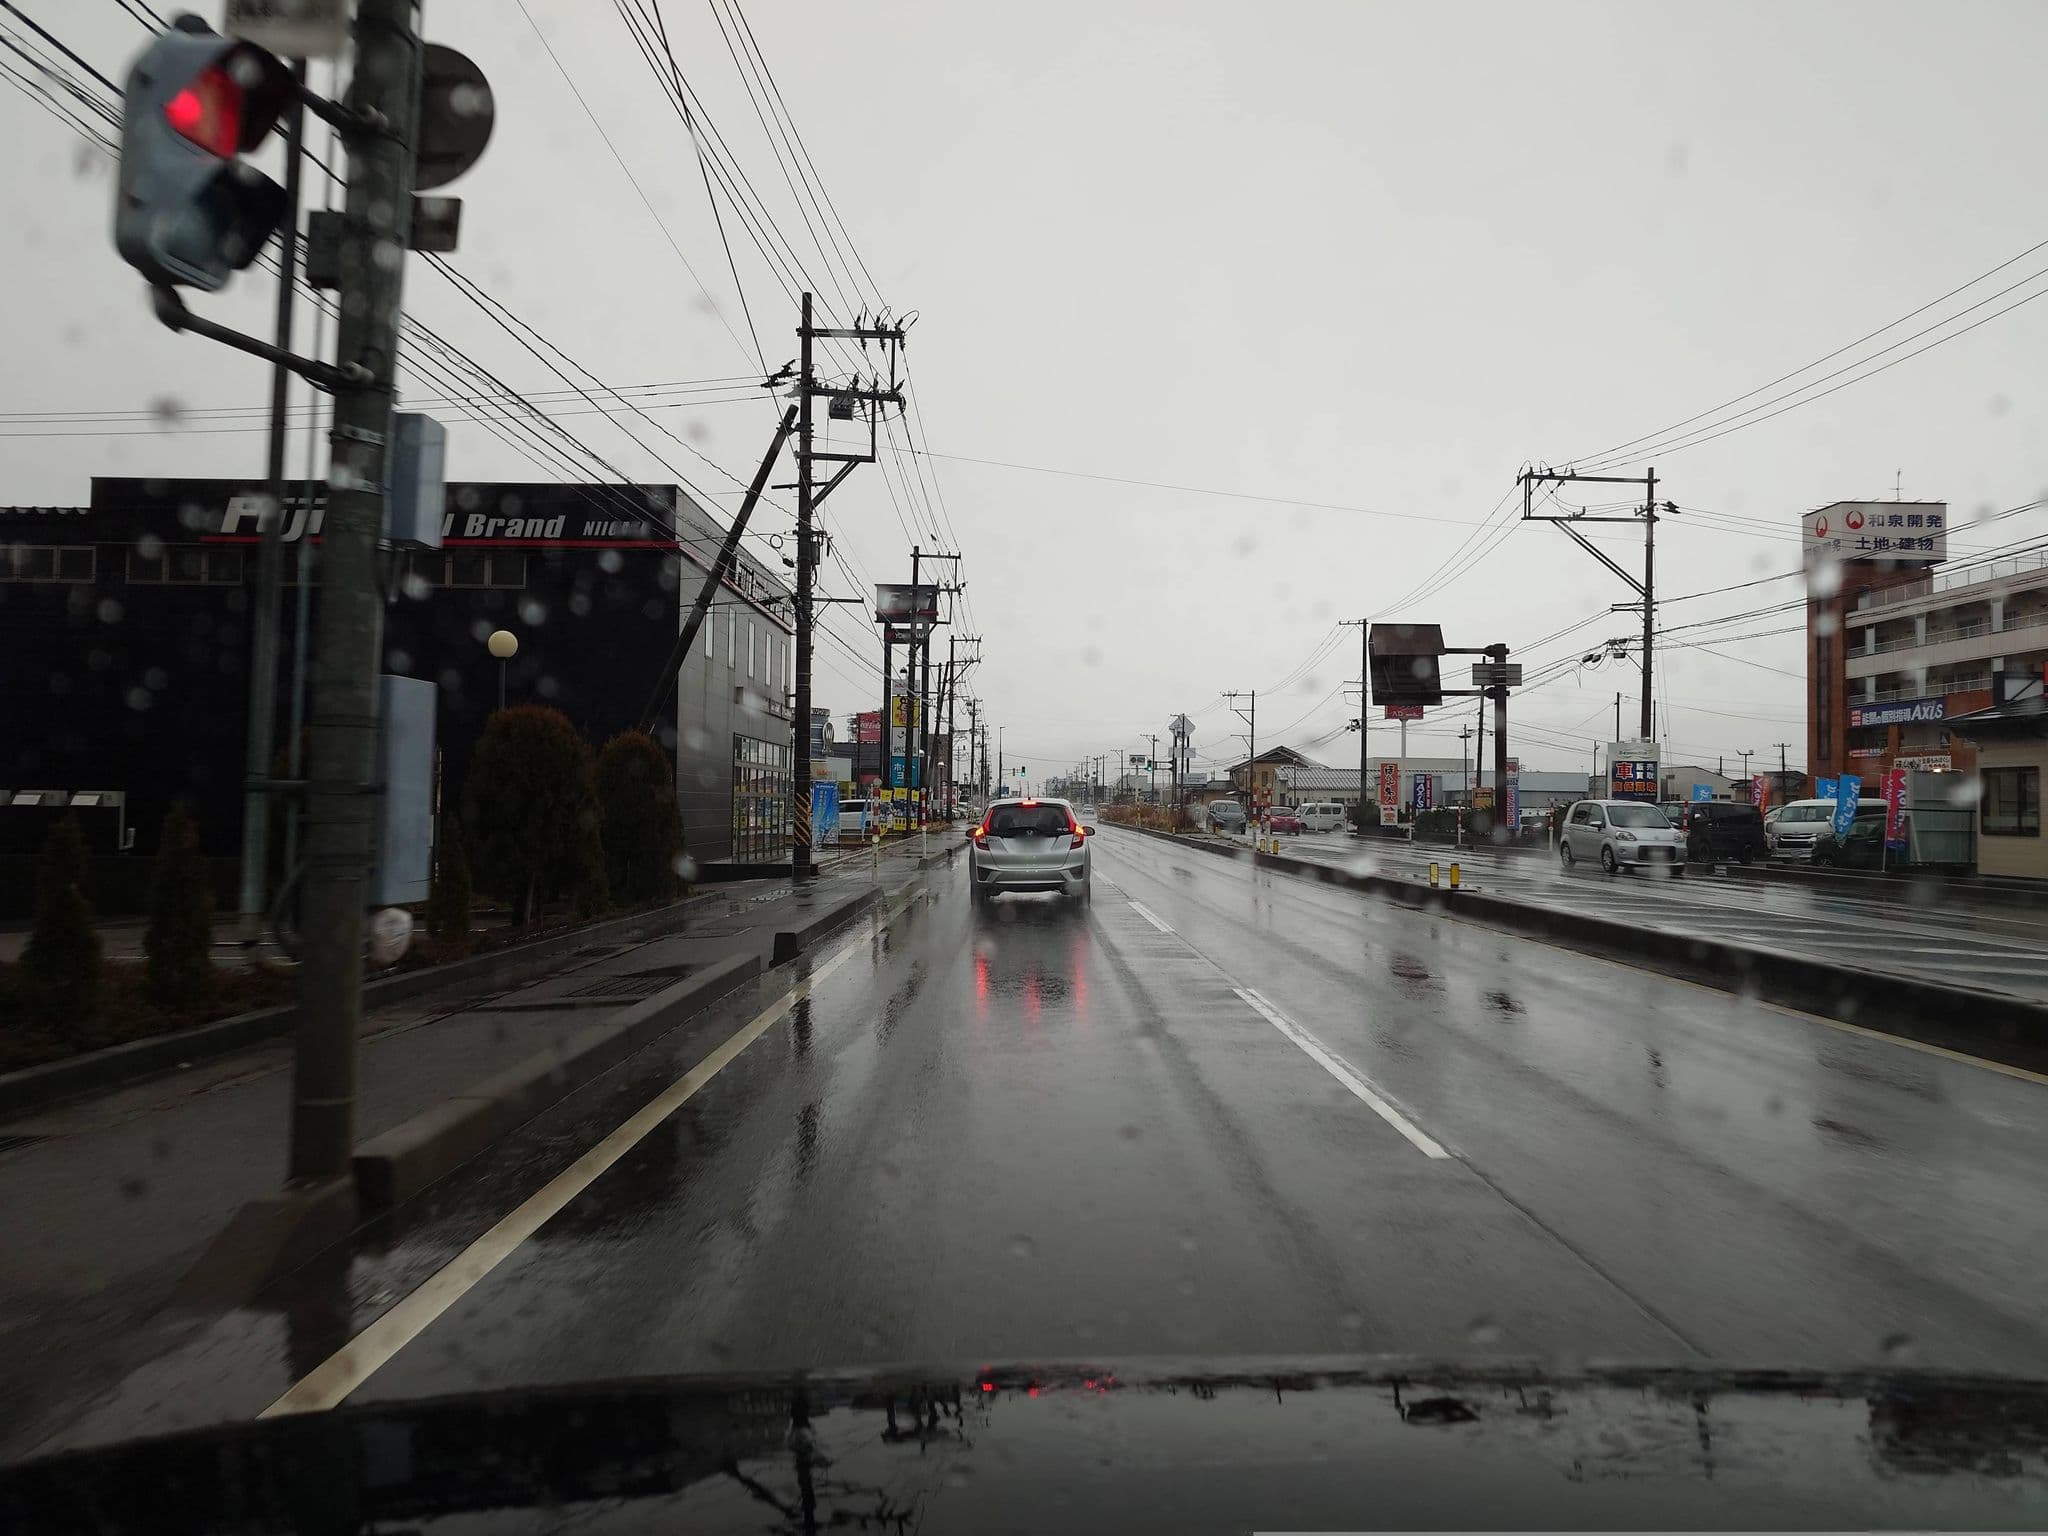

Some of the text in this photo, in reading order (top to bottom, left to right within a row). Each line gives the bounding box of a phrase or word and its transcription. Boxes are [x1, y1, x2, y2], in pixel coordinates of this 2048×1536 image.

[463, 513, 566, 539] Brand
[1868, 514, 1943, 528] 和泉開発
